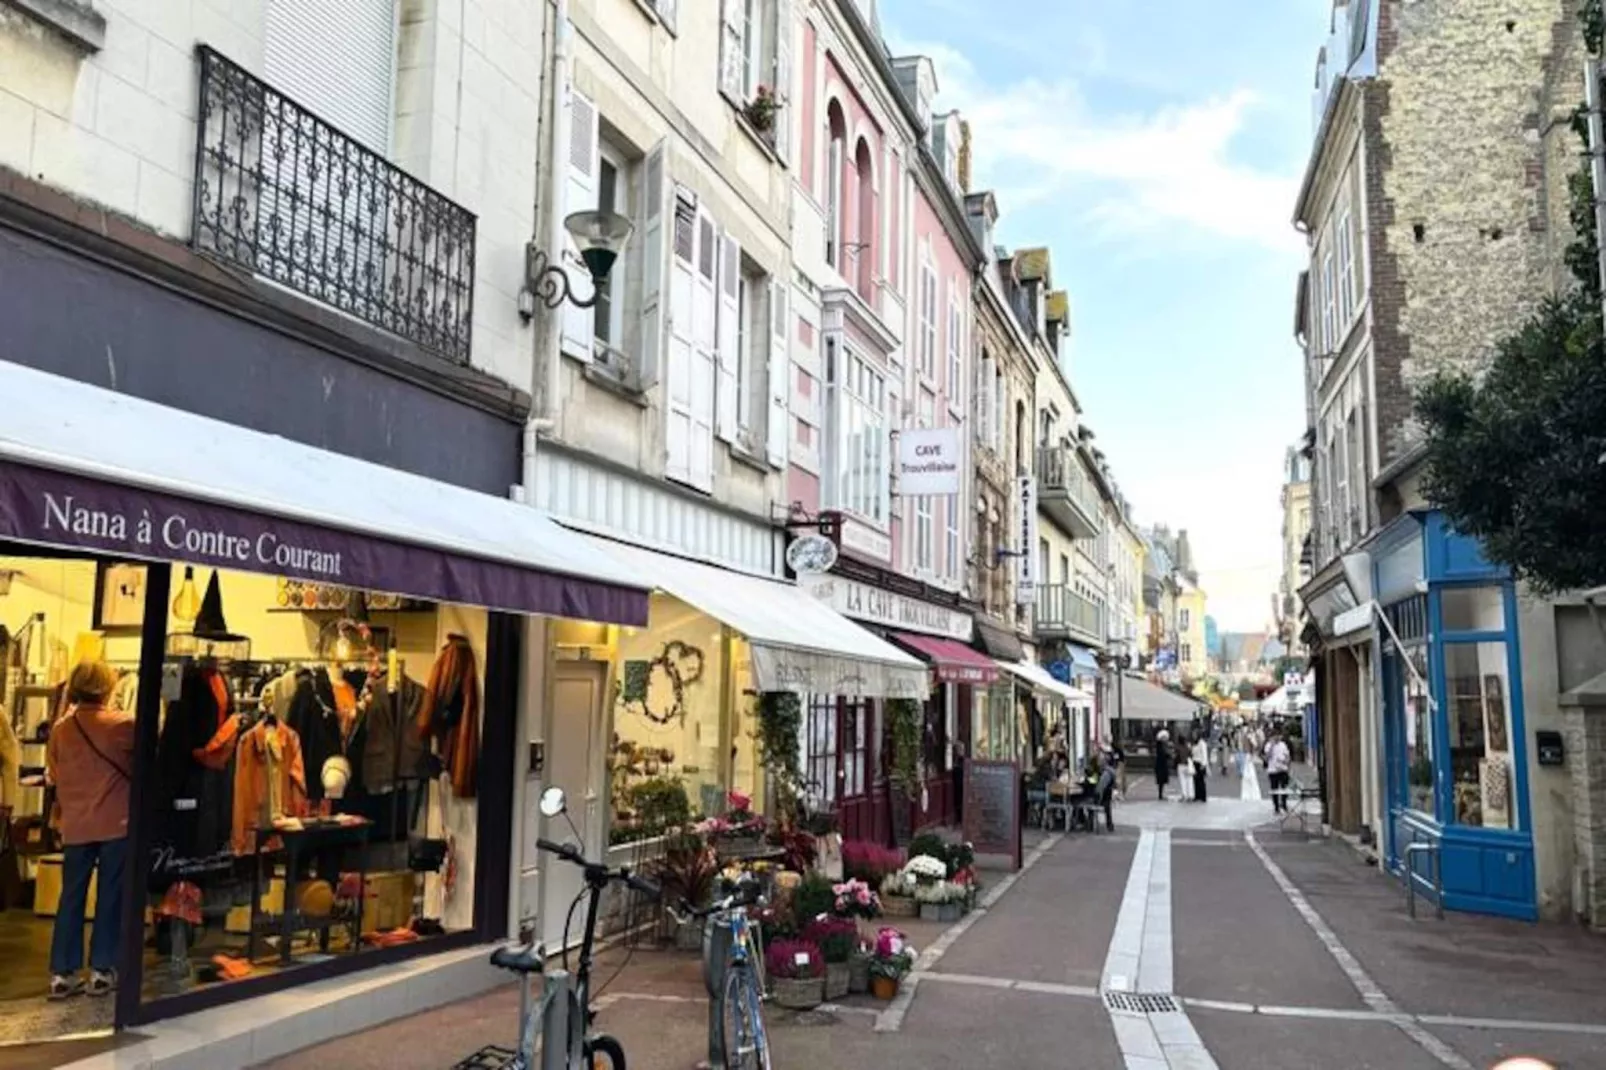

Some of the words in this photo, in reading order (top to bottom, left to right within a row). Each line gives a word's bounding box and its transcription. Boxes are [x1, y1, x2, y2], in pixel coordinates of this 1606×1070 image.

[915, 445, 941, 456] CAVE
[901, 461, 956, 473] Trouvillaise
[42, 491, 126, 540] Nana
[137, 508, 152, 544] à
[162, 514, 250, 560] Contre
[256, 532, 341, 575] Courant
[846, 583, 862, 613] LA
[868, 589, 894, 621] CAVE
